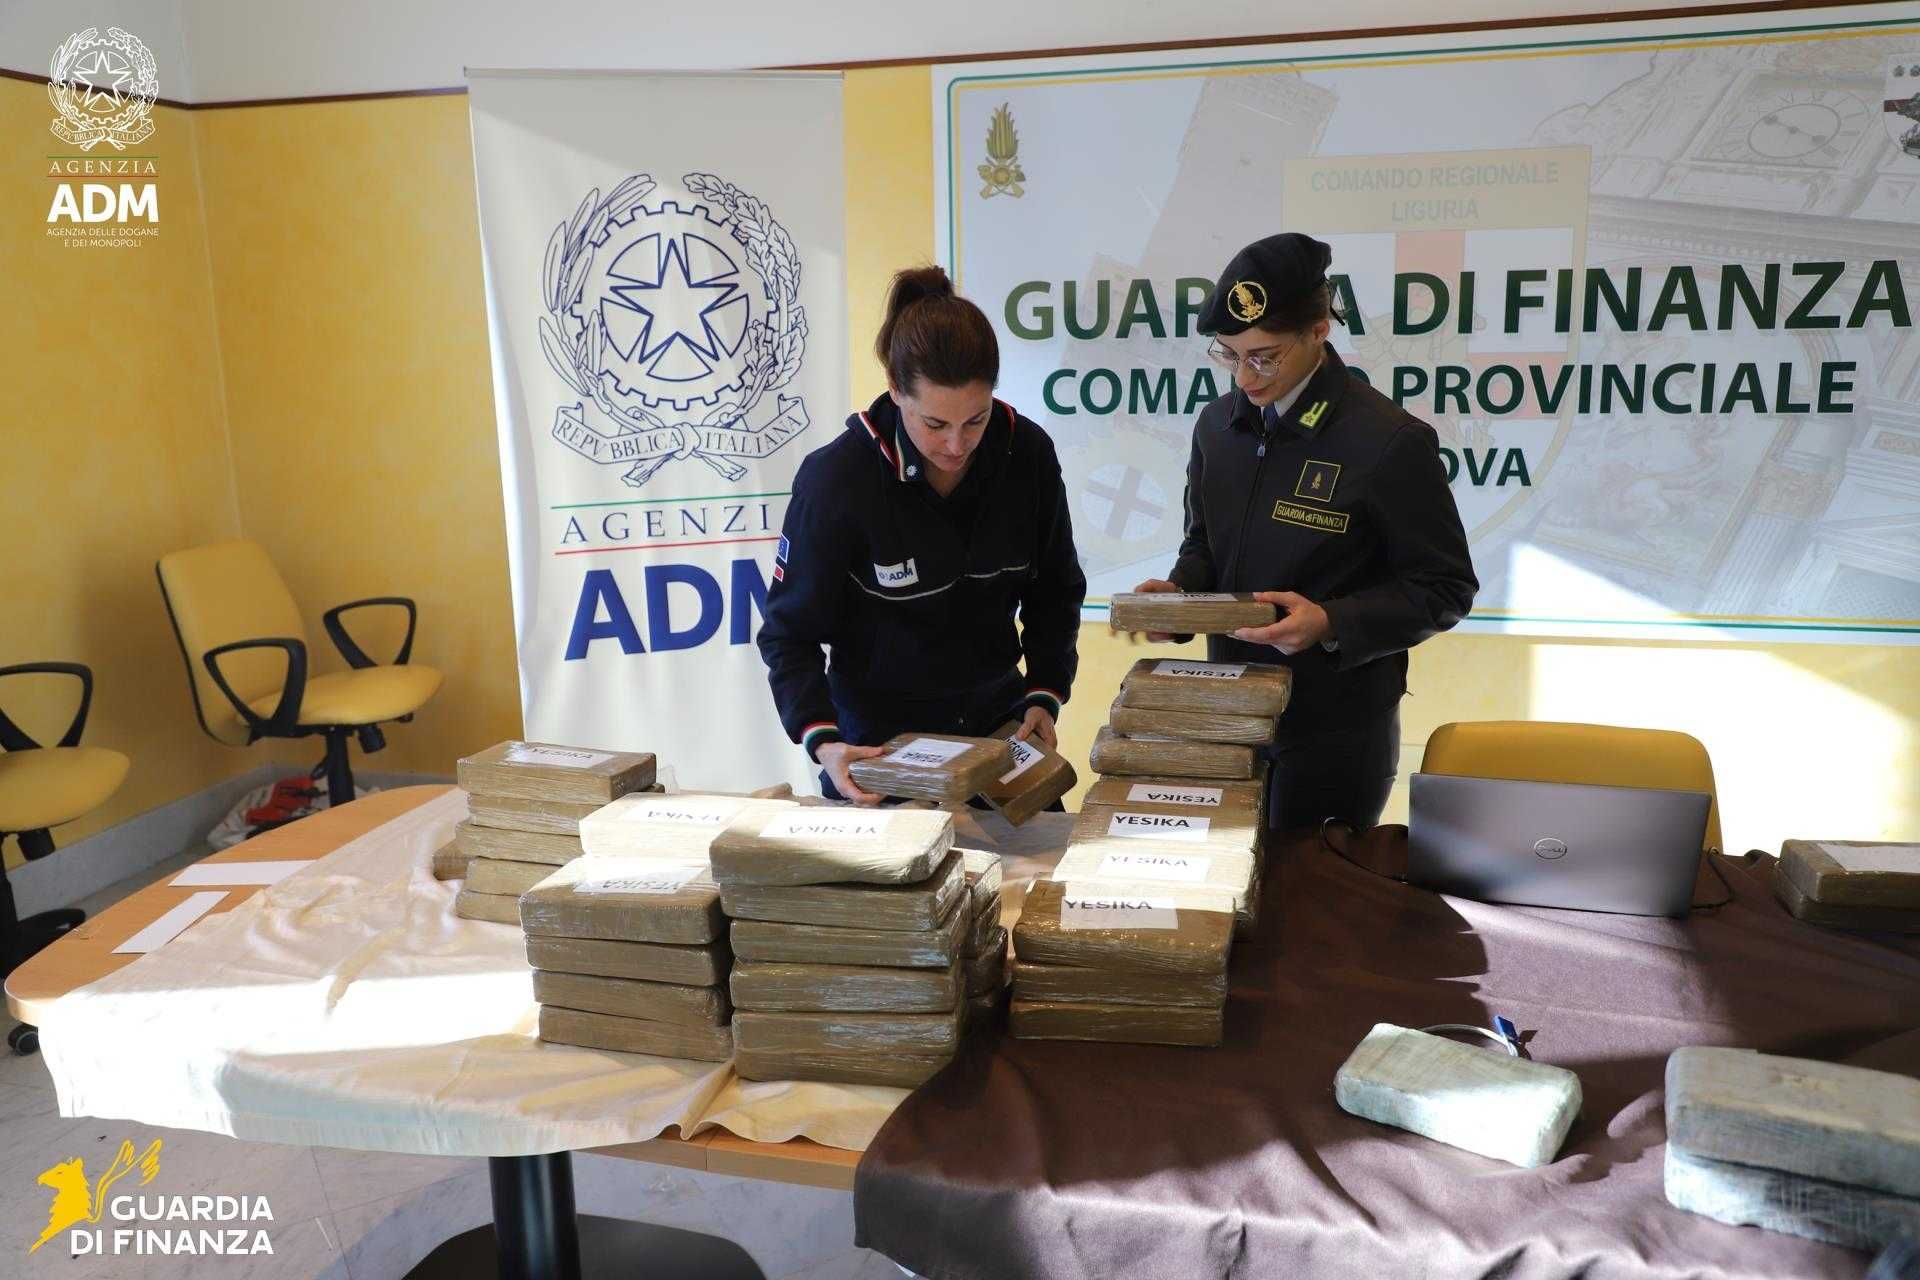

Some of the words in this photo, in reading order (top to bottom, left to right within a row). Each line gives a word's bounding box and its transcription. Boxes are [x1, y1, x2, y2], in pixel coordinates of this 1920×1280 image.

[1311, 168, 1424, 192] COMANDO
[1430, 162, 1560, 188] REGIONALE
[1392, 198, 1479, 222] LIGURIA
[1004, 274, 1366, 341] GUARA
[1392, 270, 1475, 337] DI
[1503, 259, 1913, 334] FINANZA
[1392, 361, 1857, 415] PROVINCIALE
[560, 503, 771, 545] AGENZI
[1171, 668, 1238, 679] YESIKA
[1147, 792, 1219, 804] YESIKA
[1114, 815, 1191, 828] YESIKA
[1063, 899, 1153, 911] YESIKA
